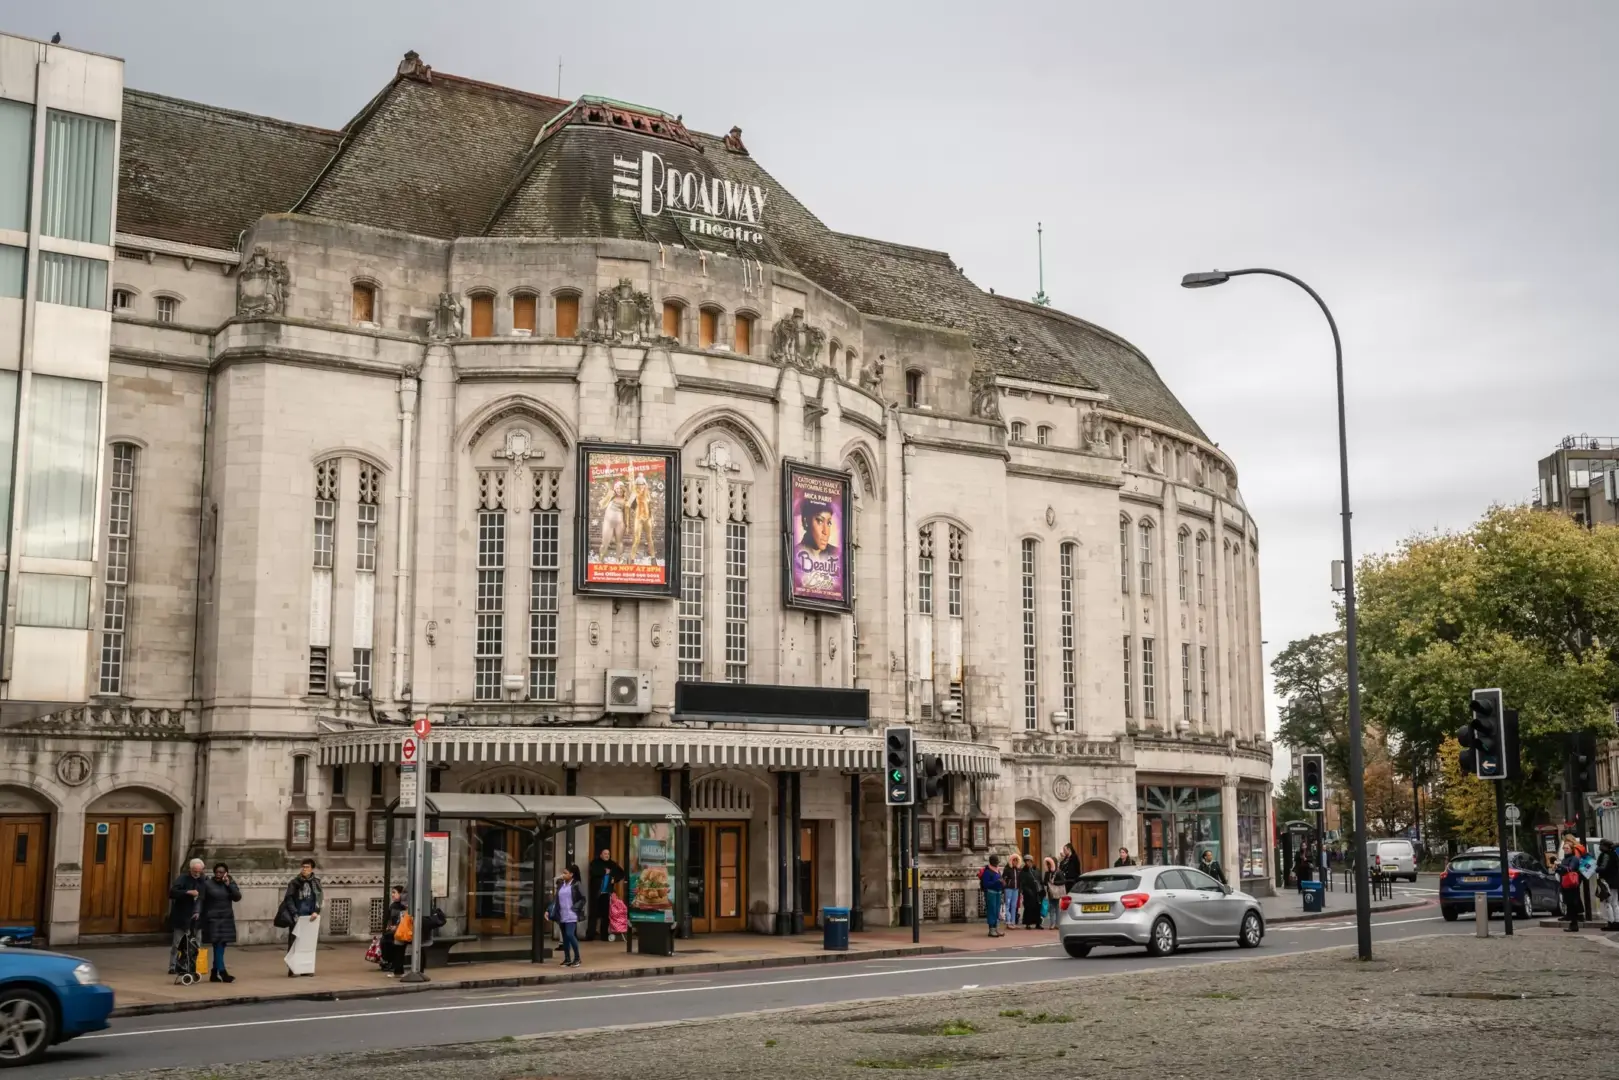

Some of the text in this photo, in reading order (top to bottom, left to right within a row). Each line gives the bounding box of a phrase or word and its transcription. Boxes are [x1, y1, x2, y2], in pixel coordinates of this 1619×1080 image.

[612, 153, 641, 205] THE
[641, 150, 769, 224] BROADWAY
[689, 217, 764, 244] Theatre
[797, 550, 840, 578] Beauty
[417, 720, 426, 733] J
